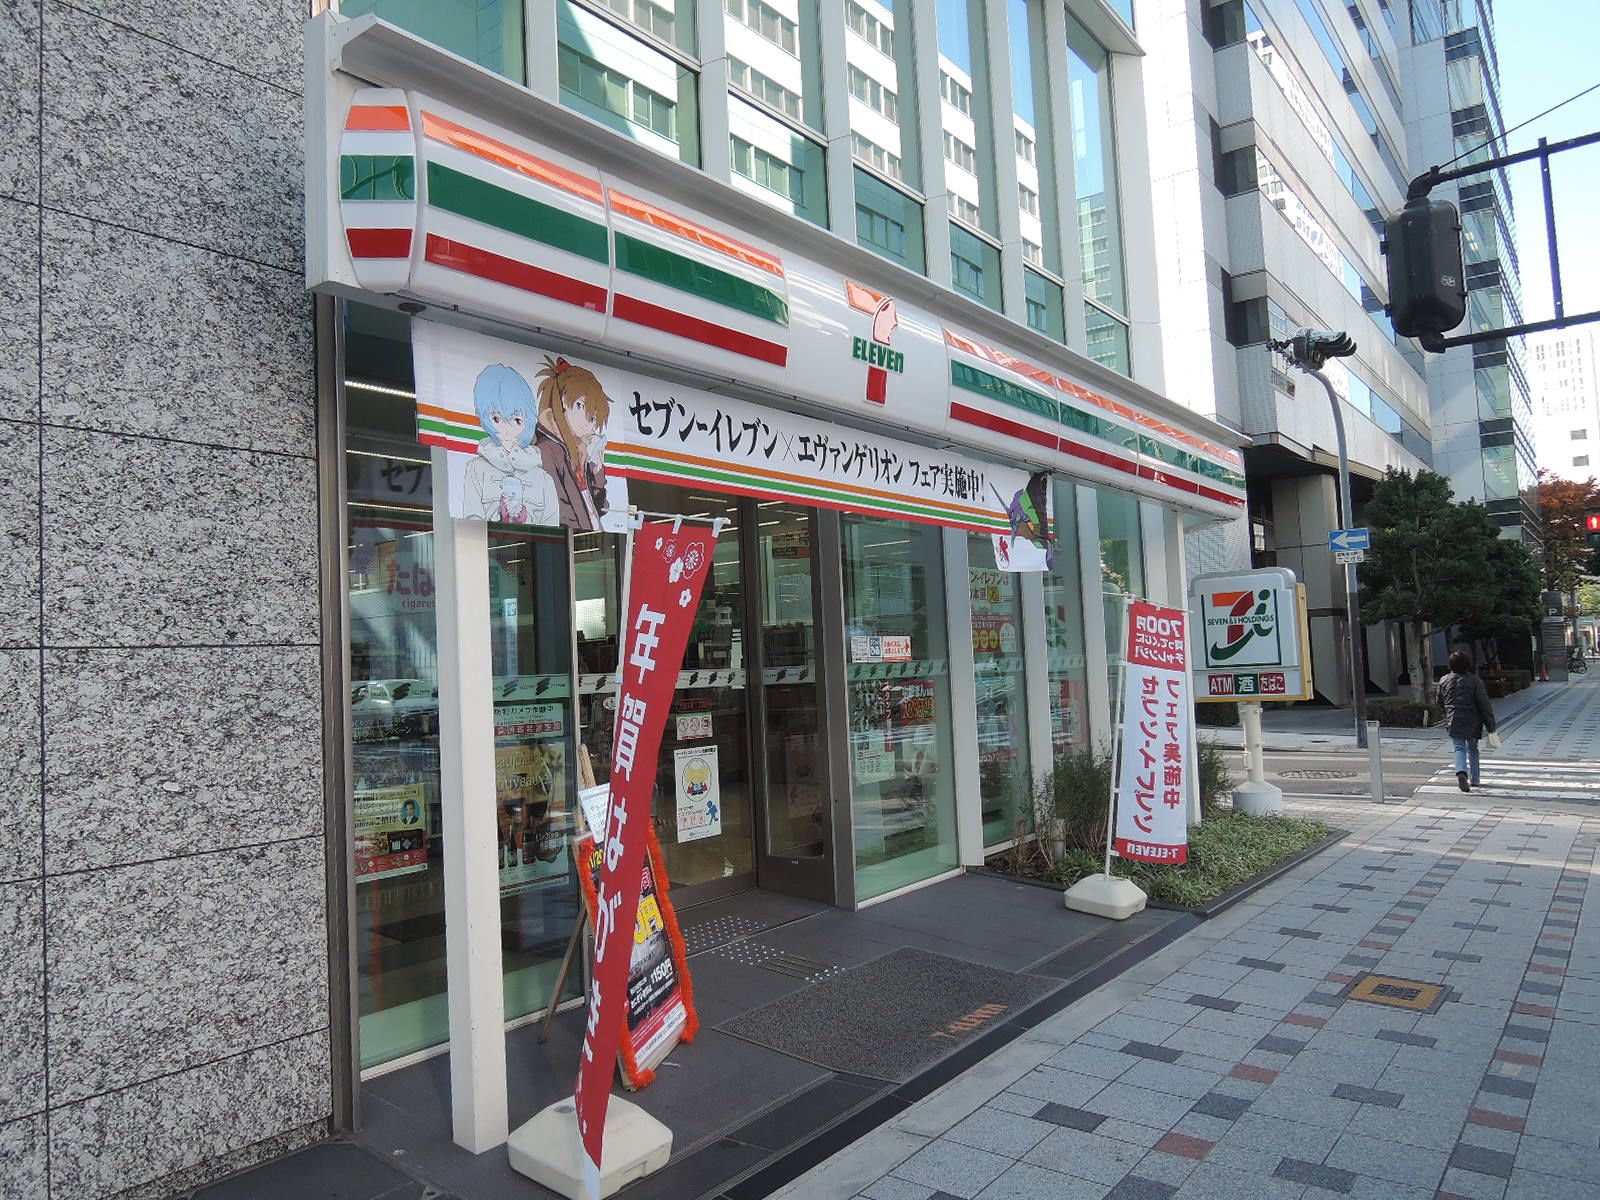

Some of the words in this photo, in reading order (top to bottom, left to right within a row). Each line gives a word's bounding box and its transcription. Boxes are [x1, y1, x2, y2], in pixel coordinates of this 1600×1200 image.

[1210, 677, 1232, 693] ATM
[1238, 676, 1255, 692] 酒
[1260, 676, 1285, 692] たばこ
